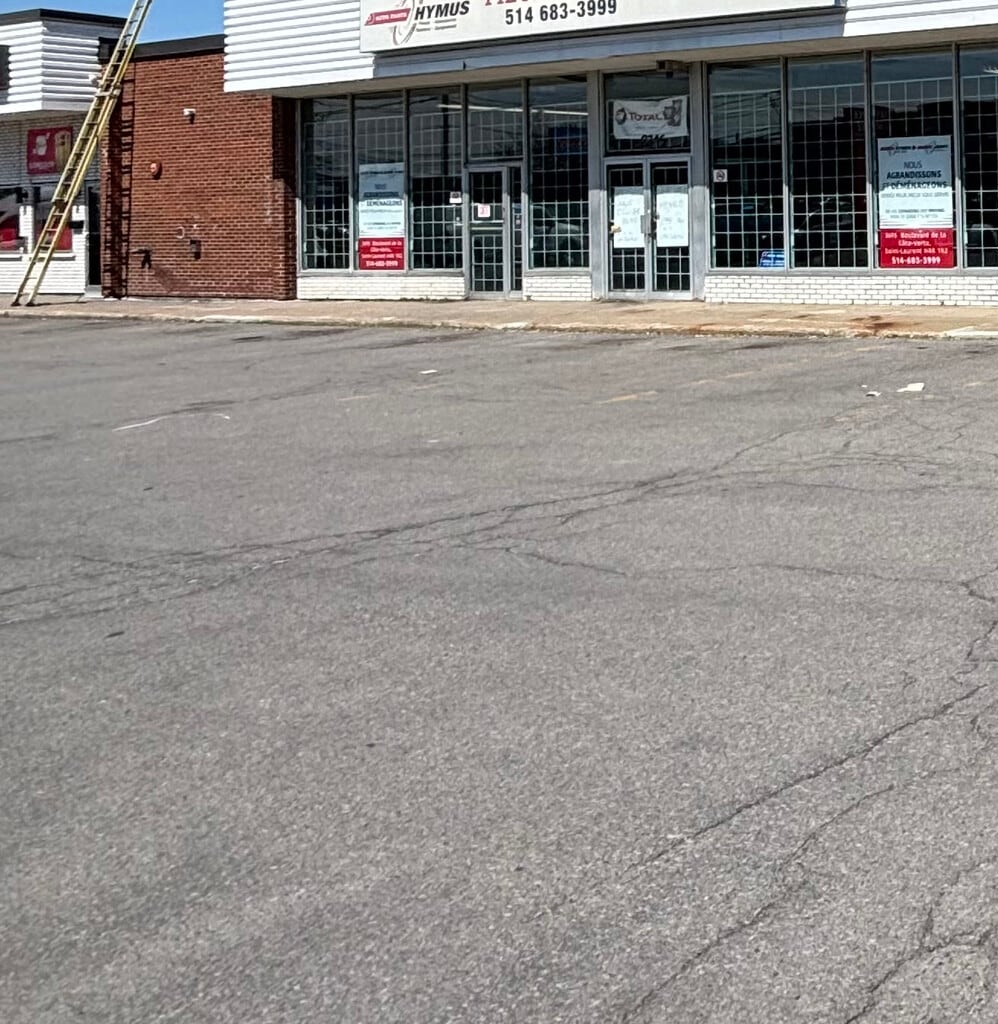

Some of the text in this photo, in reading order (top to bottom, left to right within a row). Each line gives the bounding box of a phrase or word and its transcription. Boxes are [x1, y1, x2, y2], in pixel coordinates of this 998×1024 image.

[414, 0, 470, 21] HYMUS
[505, 7, 534, 25] 514
[903, 160, 922, 169] NOUS
[891, 257, 941, 265] 514-683-3999
